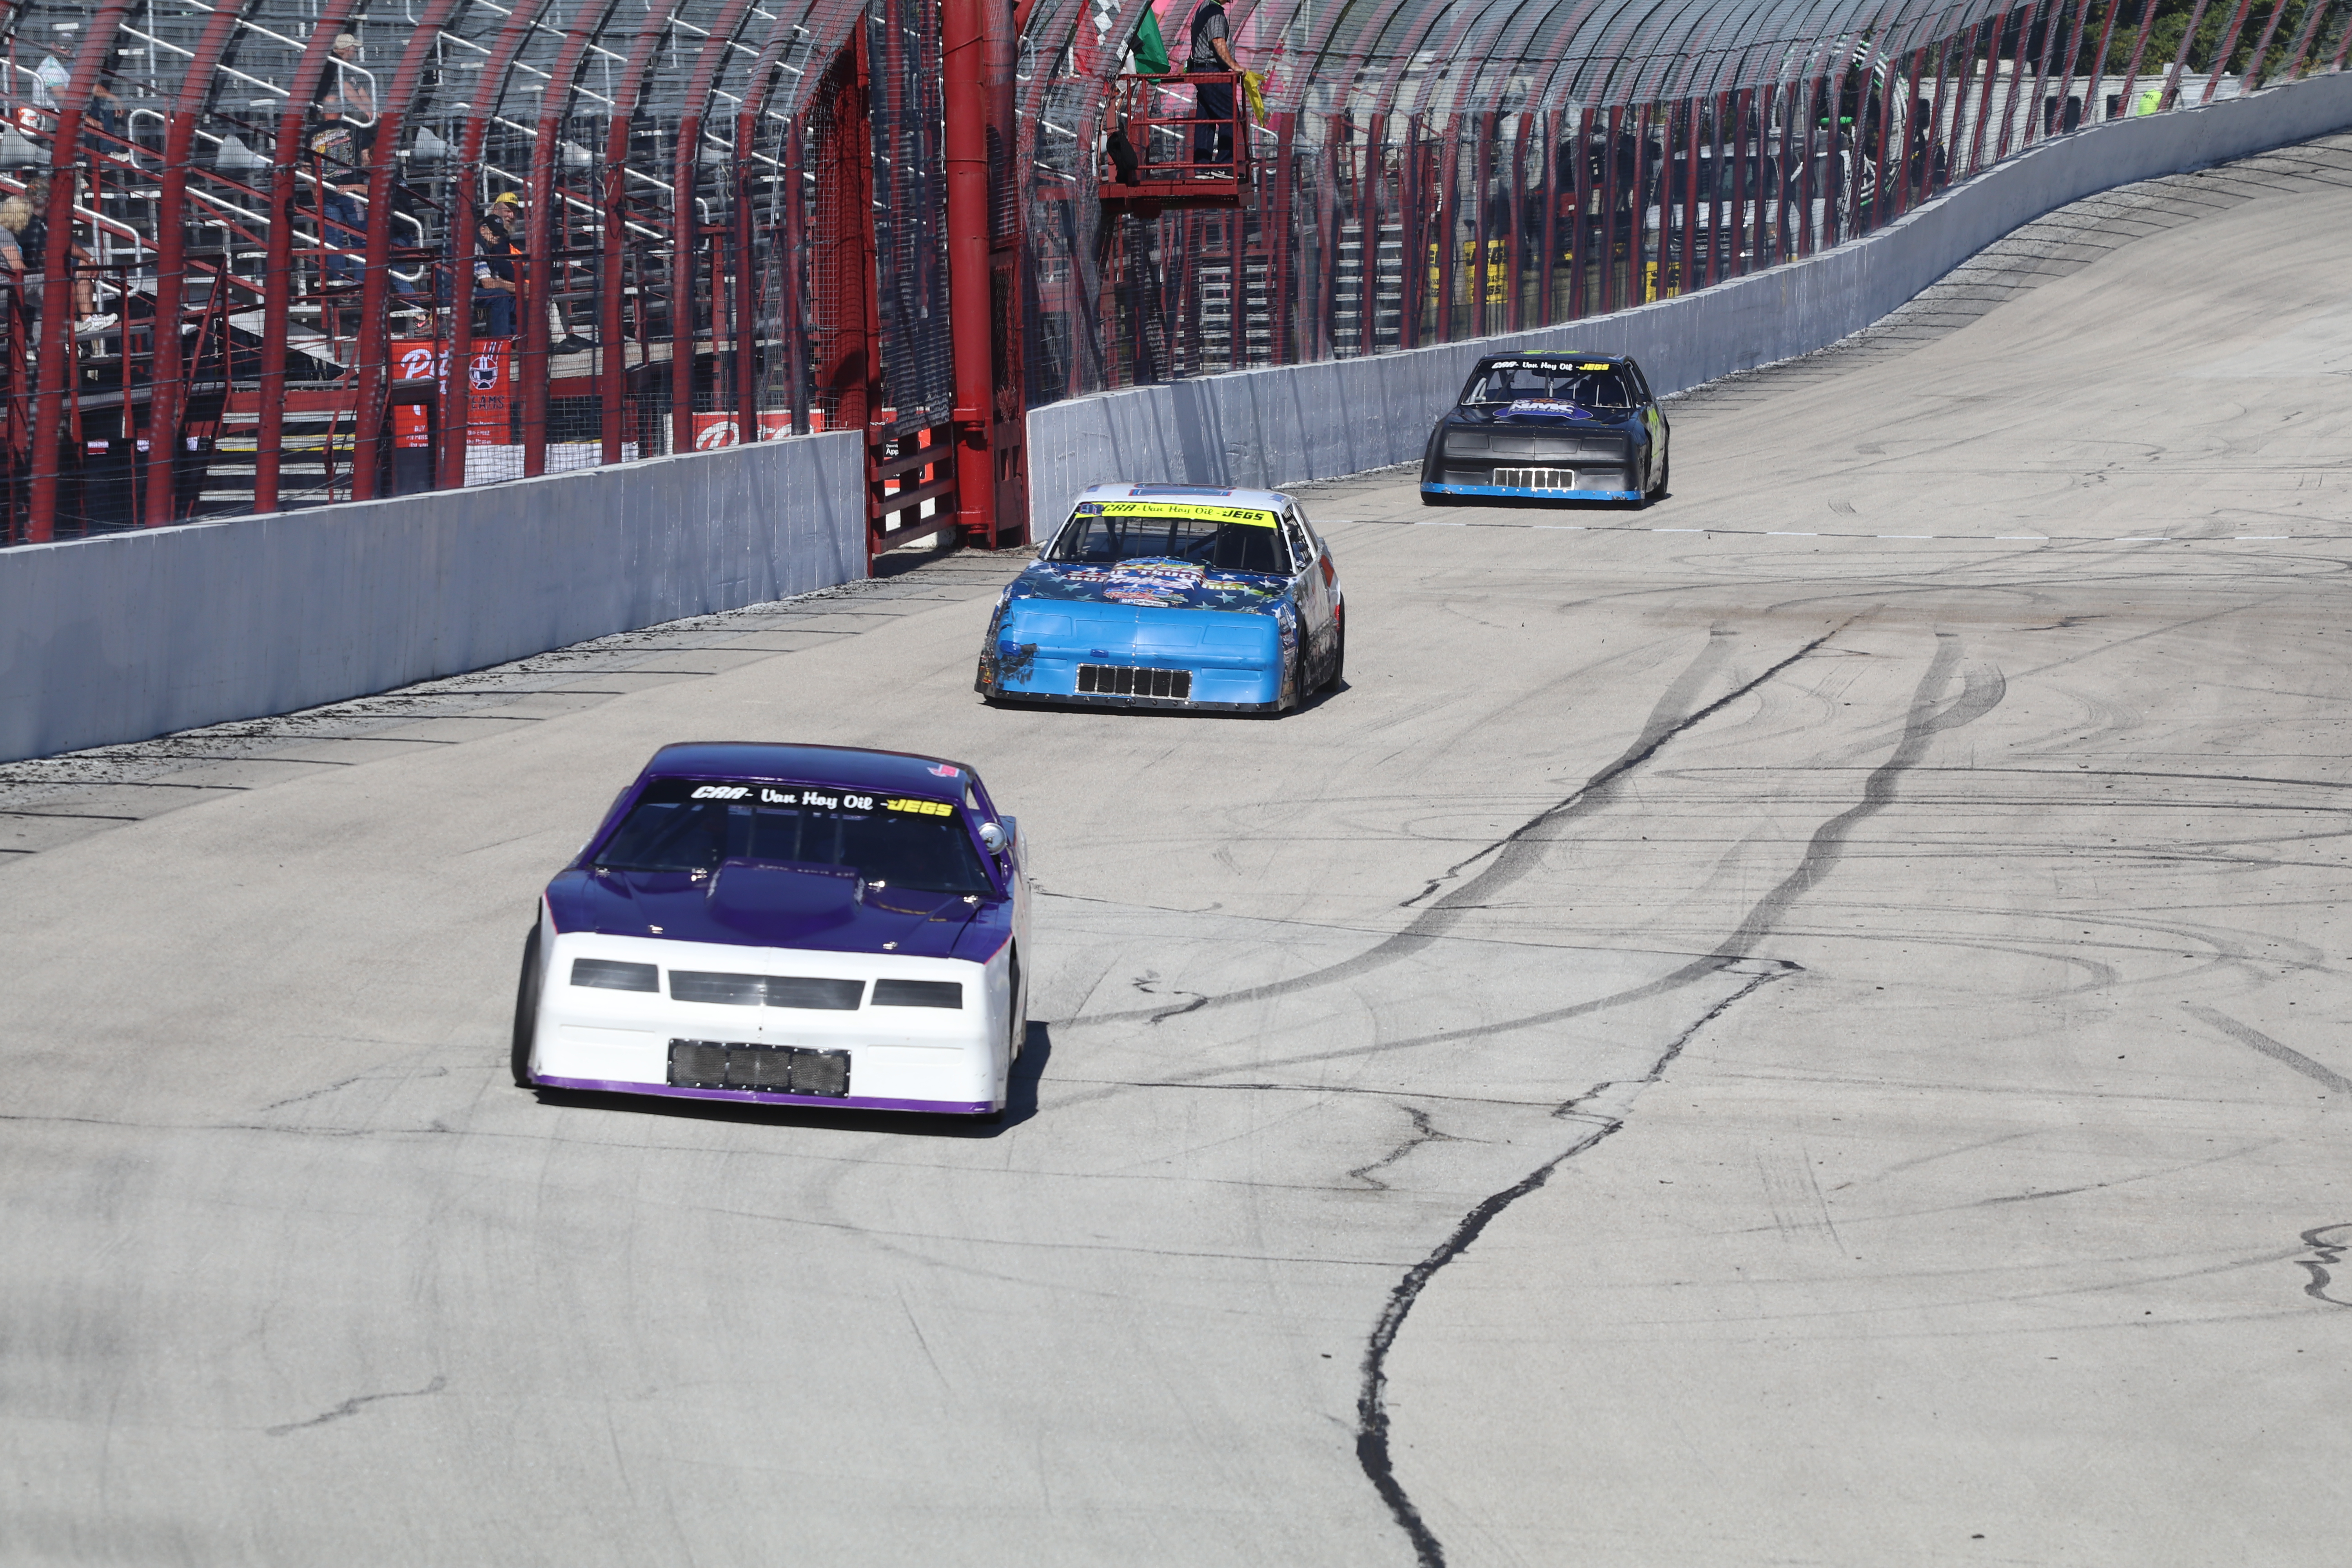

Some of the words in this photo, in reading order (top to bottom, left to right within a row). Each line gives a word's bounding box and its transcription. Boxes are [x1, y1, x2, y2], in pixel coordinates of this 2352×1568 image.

[1541, 362, 1557, 370] Hoy
[472, 395, 505, 409] EAMS
[1169, 506, 1190, 514] Hoy
[761, 788, 798, 804] Van
[802, 791, 838, 809] Hoy
[843, 795, 873, 810] Oil
